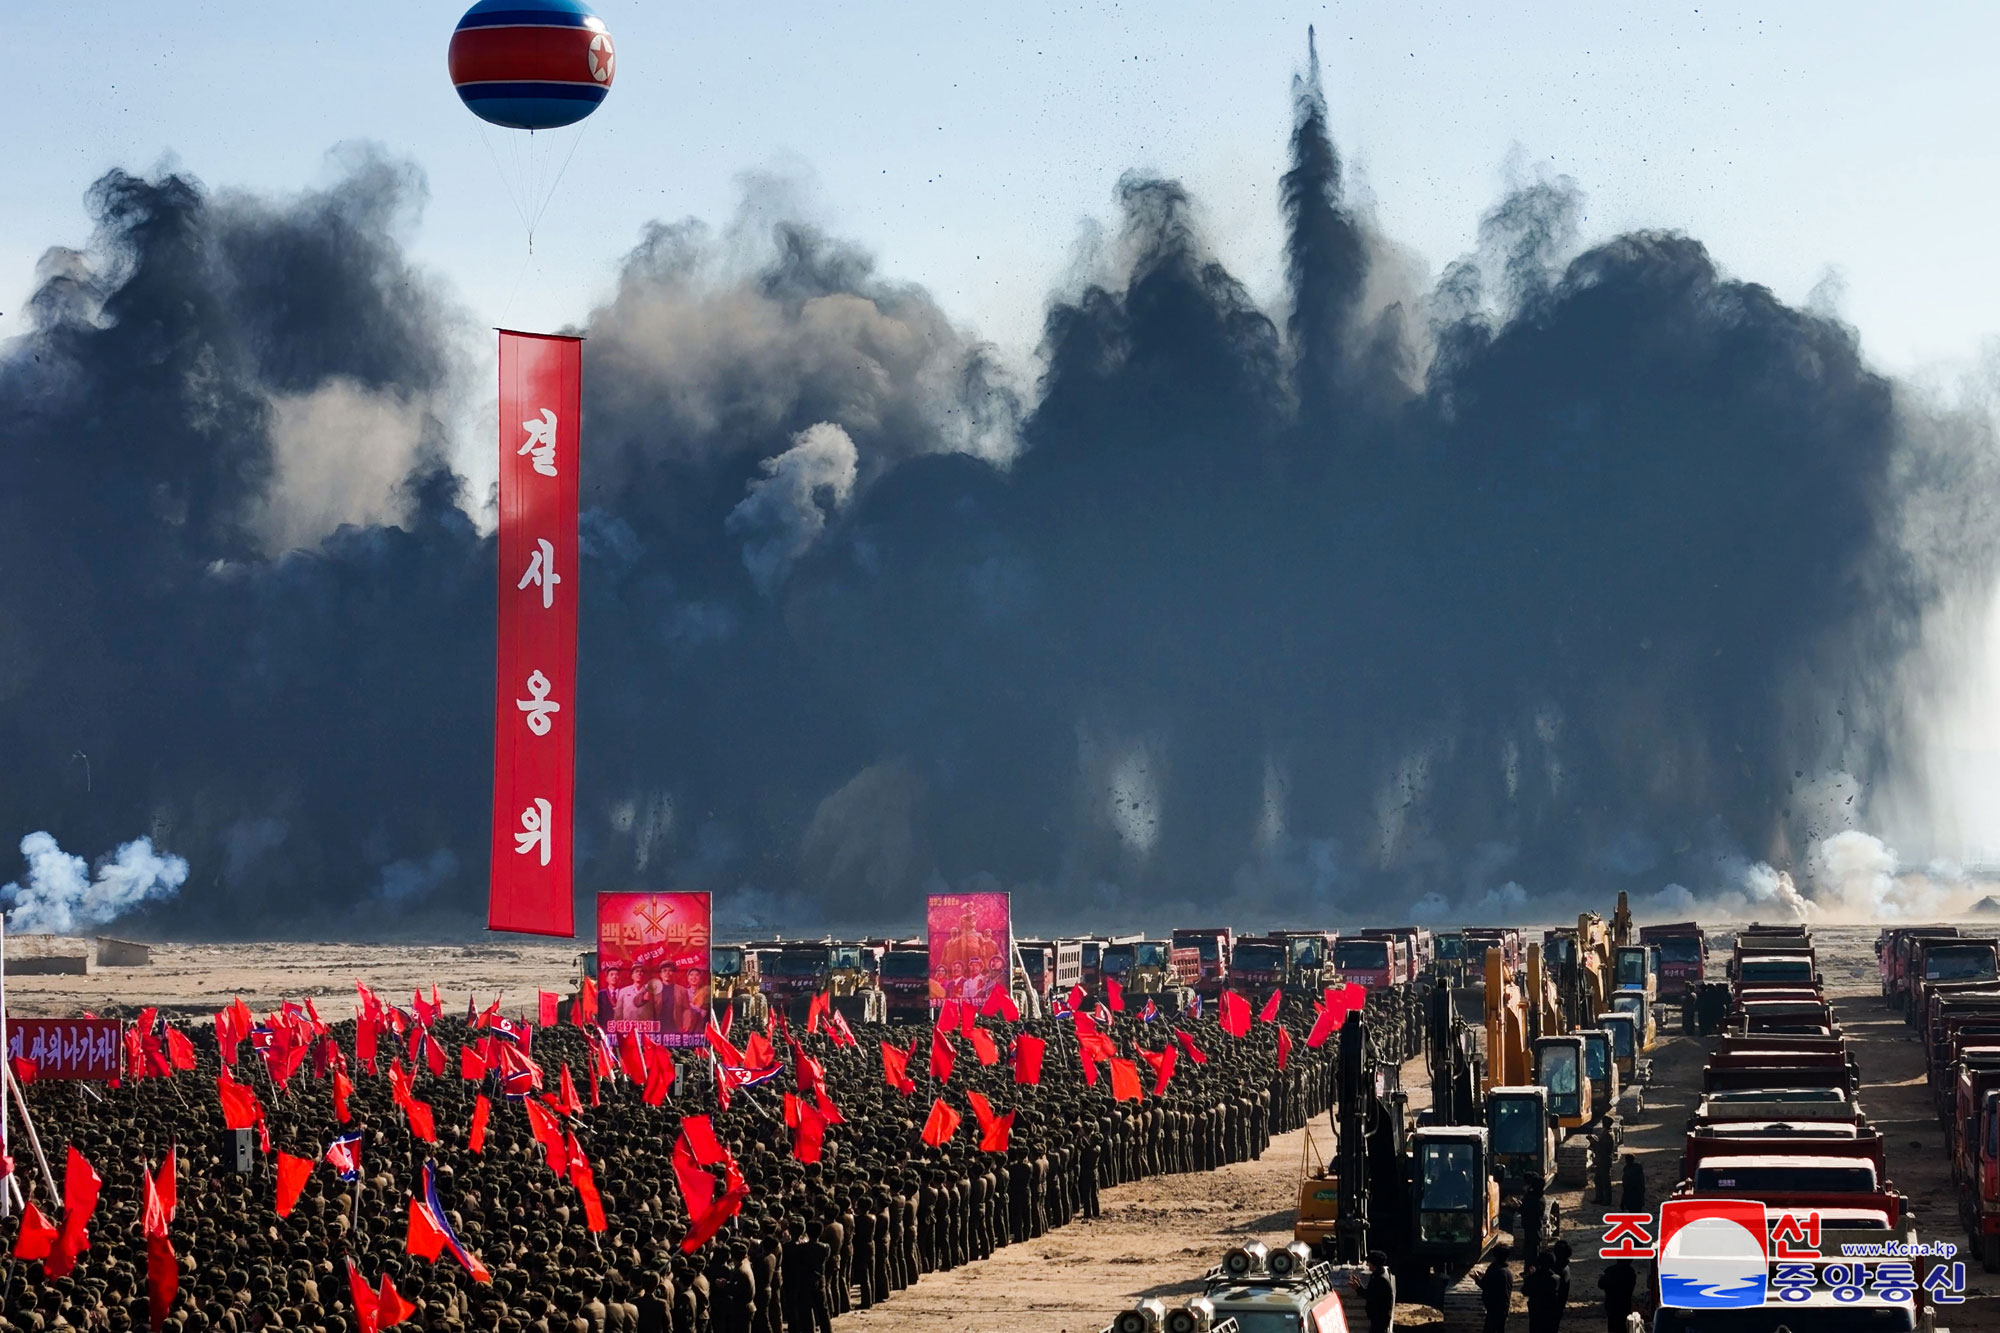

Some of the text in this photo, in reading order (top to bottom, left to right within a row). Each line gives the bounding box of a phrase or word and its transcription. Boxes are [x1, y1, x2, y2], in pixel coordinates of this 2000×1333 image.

[514, 408, 561, 867] 결사옹위
[601, 923, 709, 946] 백전 백승
[29, 1026, 116, 1071] 싸워나가자!
